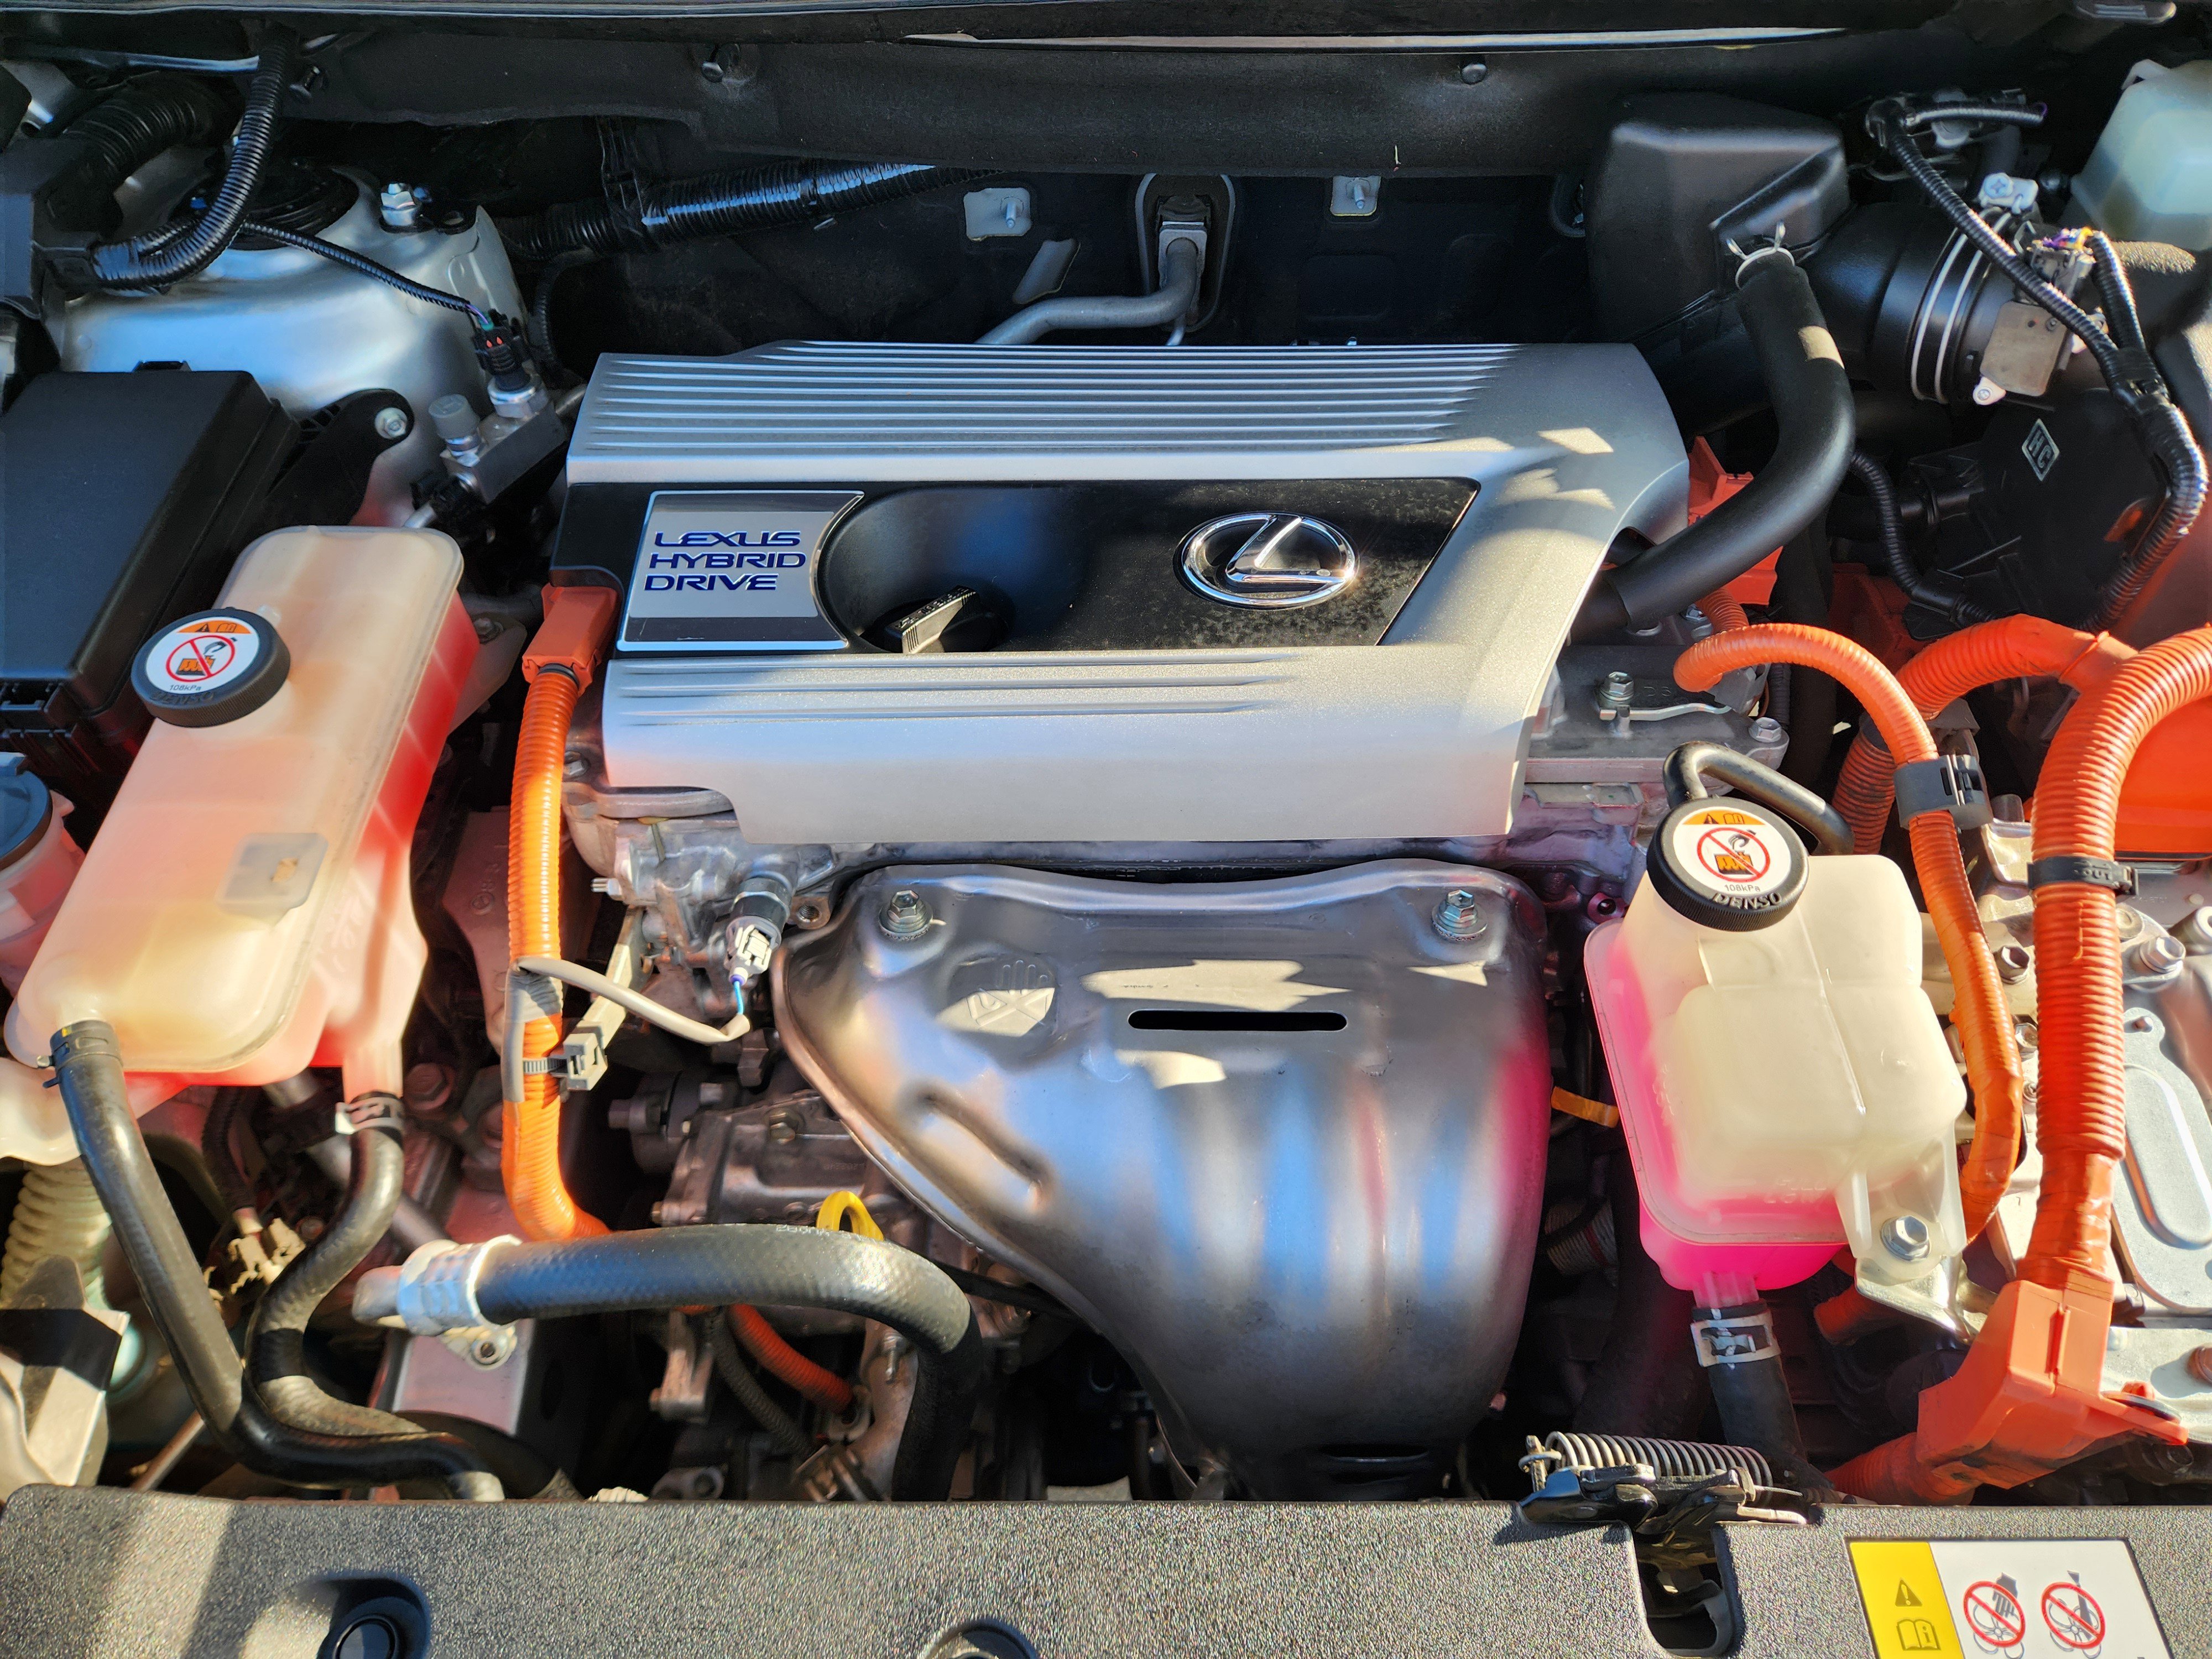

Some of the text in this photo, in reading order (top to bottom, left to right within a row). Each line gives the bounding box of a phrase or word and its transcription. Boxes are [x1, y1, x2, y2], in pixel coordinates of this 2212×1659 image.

[654, 531, 801, 547] LEXUS
[649, 552, 807, 568] HYBRID
[644, 573, 779, 591] DRIVE
[1724, 884, 1761, 893] 108kPa
[1712, 892, 1782, 910] DENSO
